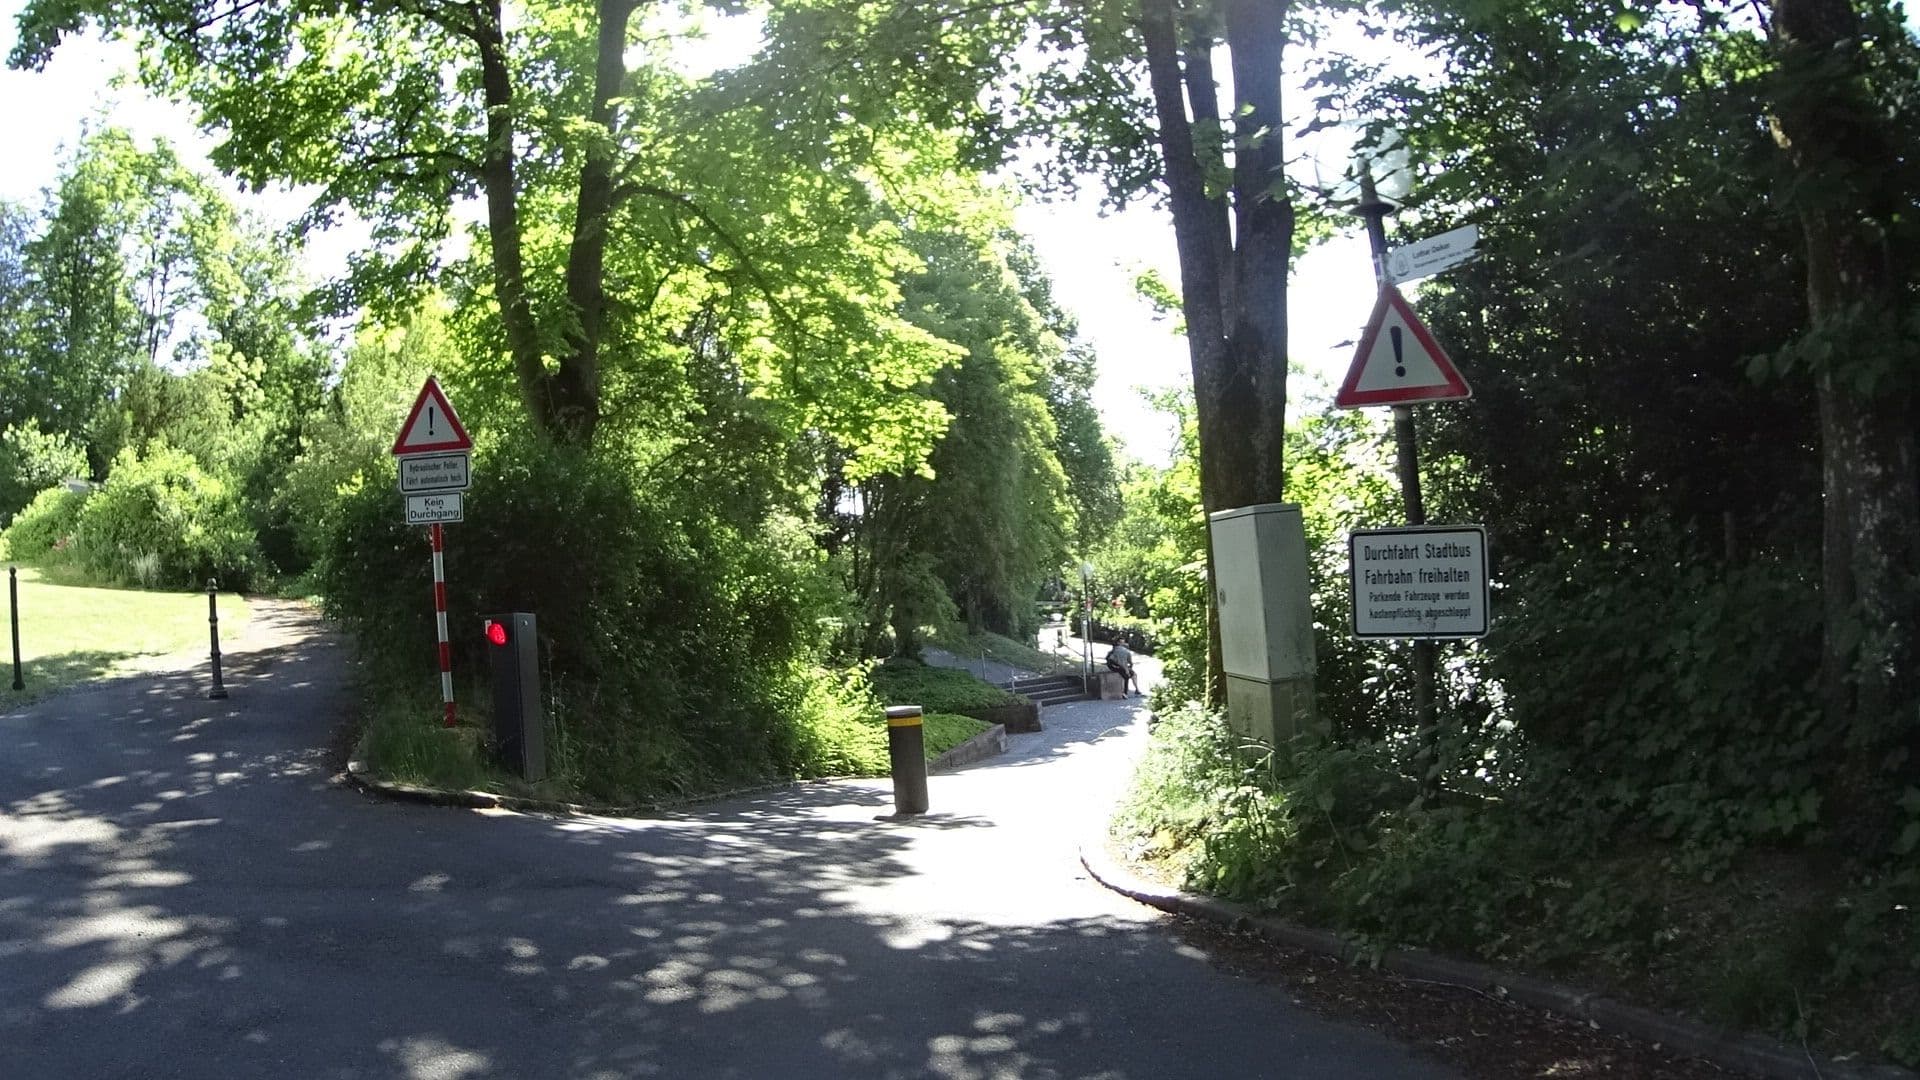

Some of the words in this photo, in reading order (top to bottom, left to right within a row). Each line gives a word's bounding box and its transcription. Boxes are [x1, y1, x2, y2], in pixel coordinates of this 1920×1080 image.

[424, 497, 444, 507] Kein
[410, 508, 459, 519] Durchgang
[1364, 544, 1419, 561] Durchfahrt
[1425, 542, 1471, 559] Stadtbus
[1365, 569, 1413, 584] Fahrbahn
[1418, 567, 1470, 583] freihalten
[1368, 591, 1401, 602] Parkende
[1404, 590, 1440, 603] Fahrzeuge
[1444, 590, 1470, 600] werden
[1425, 606, 1471, 620] abgeschleppt
